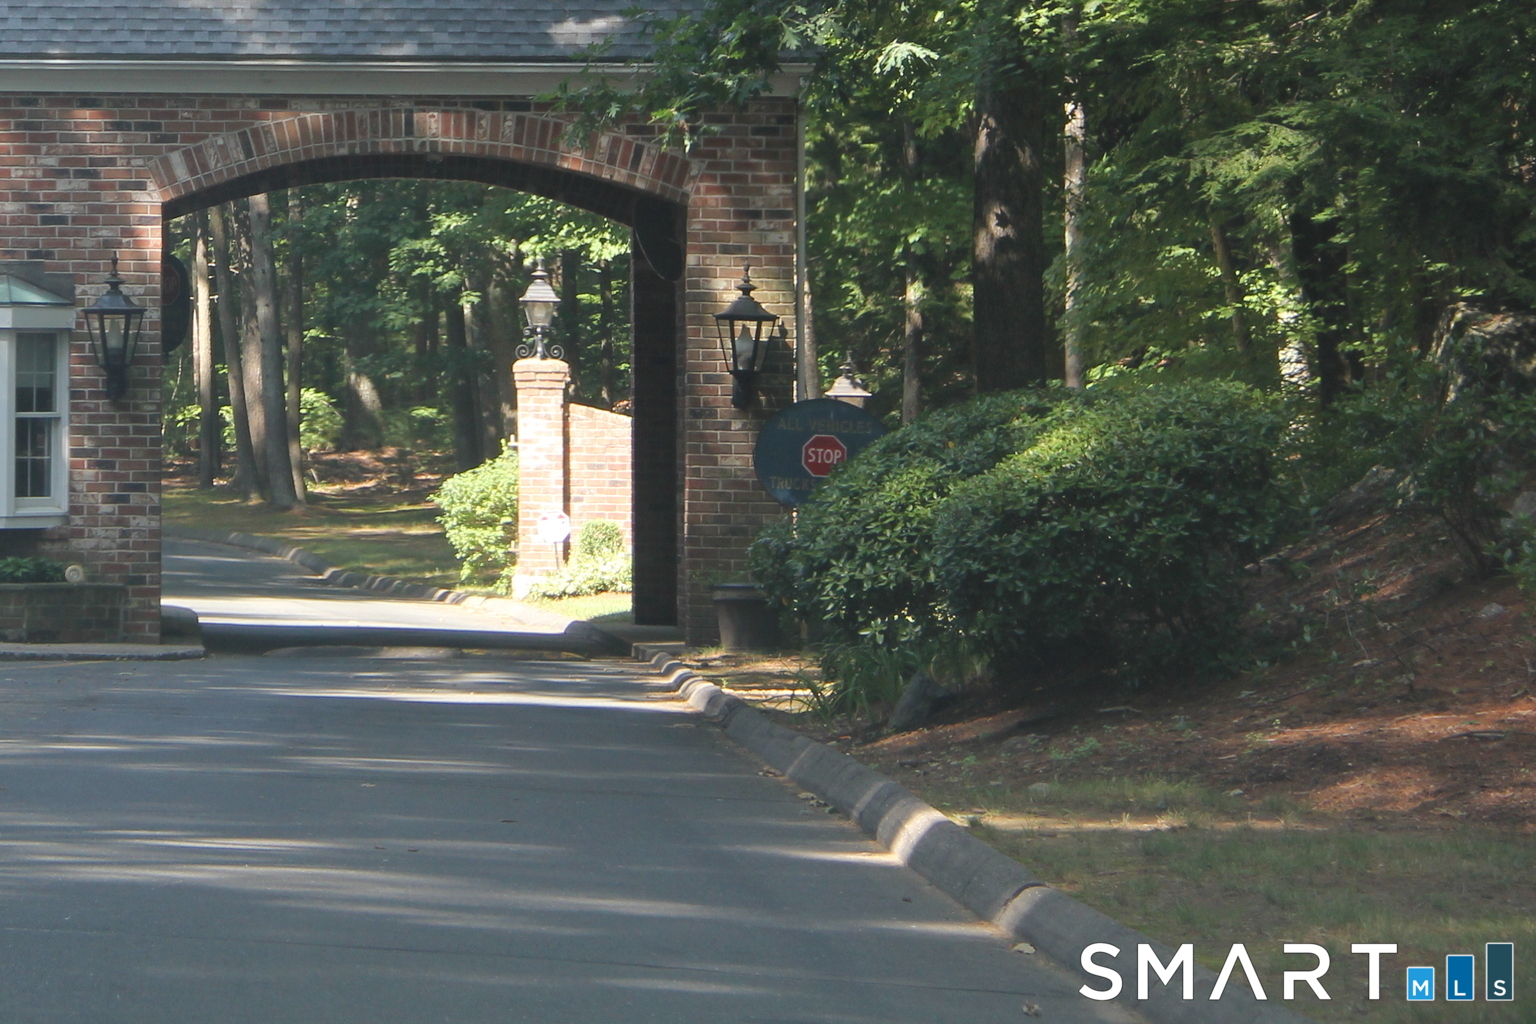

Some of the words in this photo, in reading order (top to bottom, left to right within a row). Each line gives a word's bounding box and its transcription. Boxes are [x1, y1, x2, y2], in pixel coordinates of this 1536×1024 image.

[777, 417, 803, 431] ALL
[809, 419, 873, 434] VEHICLES
[807, 448, 842, 464] STOP
